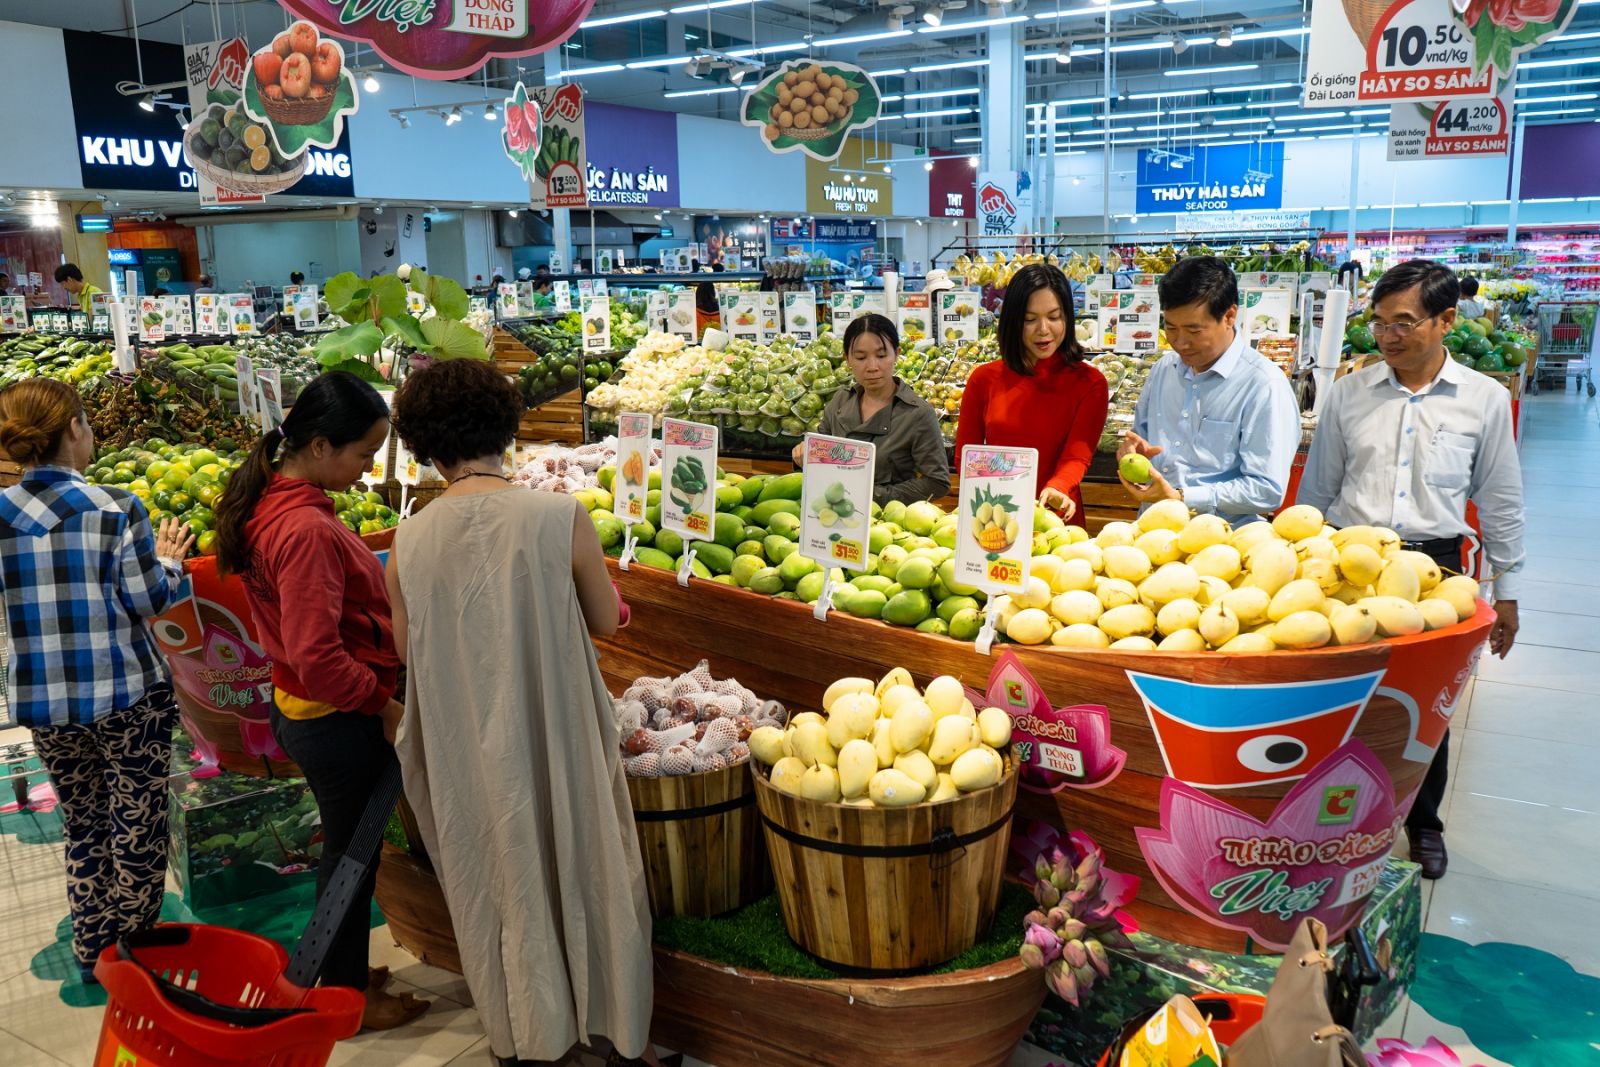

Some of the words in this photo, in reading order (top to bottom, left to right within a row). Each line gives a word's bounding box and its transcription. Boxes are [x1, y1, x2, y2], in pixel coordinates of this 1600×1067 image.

[465, 11, 515, 32] THÁP
[1383, 24, 1471, 67] 10.50
[1426, 49, 1468, 63] vnd/Kg
[1325, 73, 1356, 87] giống
[1362, 73, 1402, 94] HÃY
[1404, 77, 1431, 91] SO
[1433, 72, 1488, 89] SÁNH
[1309, 90, 1328, 101] Đài
[1330, 90, 1356, 100] Loan
[82, 136, 155, 167] KHU
[1427, 140, 1451, 152] HÃY
[1453, 141, 1470, 151] SO
[1472, 139, 1506, 150] SÁNH
[610, 167, 634, 191] ĂN
[586, 190, 649, 204] DELICATESSEN
[823, 181, 843, 201] TÀU
[835, 202, 851, 212] FRESH
[854, 203, 868, 213] TOFU
[1185, 200, 1228, 210] SEAFOOD
[1016, 714, 1047, 737] ĐẶC
[1047, 720, 1078, 744] SẢN
[1047, 757, 1077, 773] THÁP
[1220, 838, 1254, 867] TỰ
[1256, 837, 1316, 866] HÀO
[1317, 832, 1368, 865] ĐẶC
[1209, 868, 1334, 922] Việt
